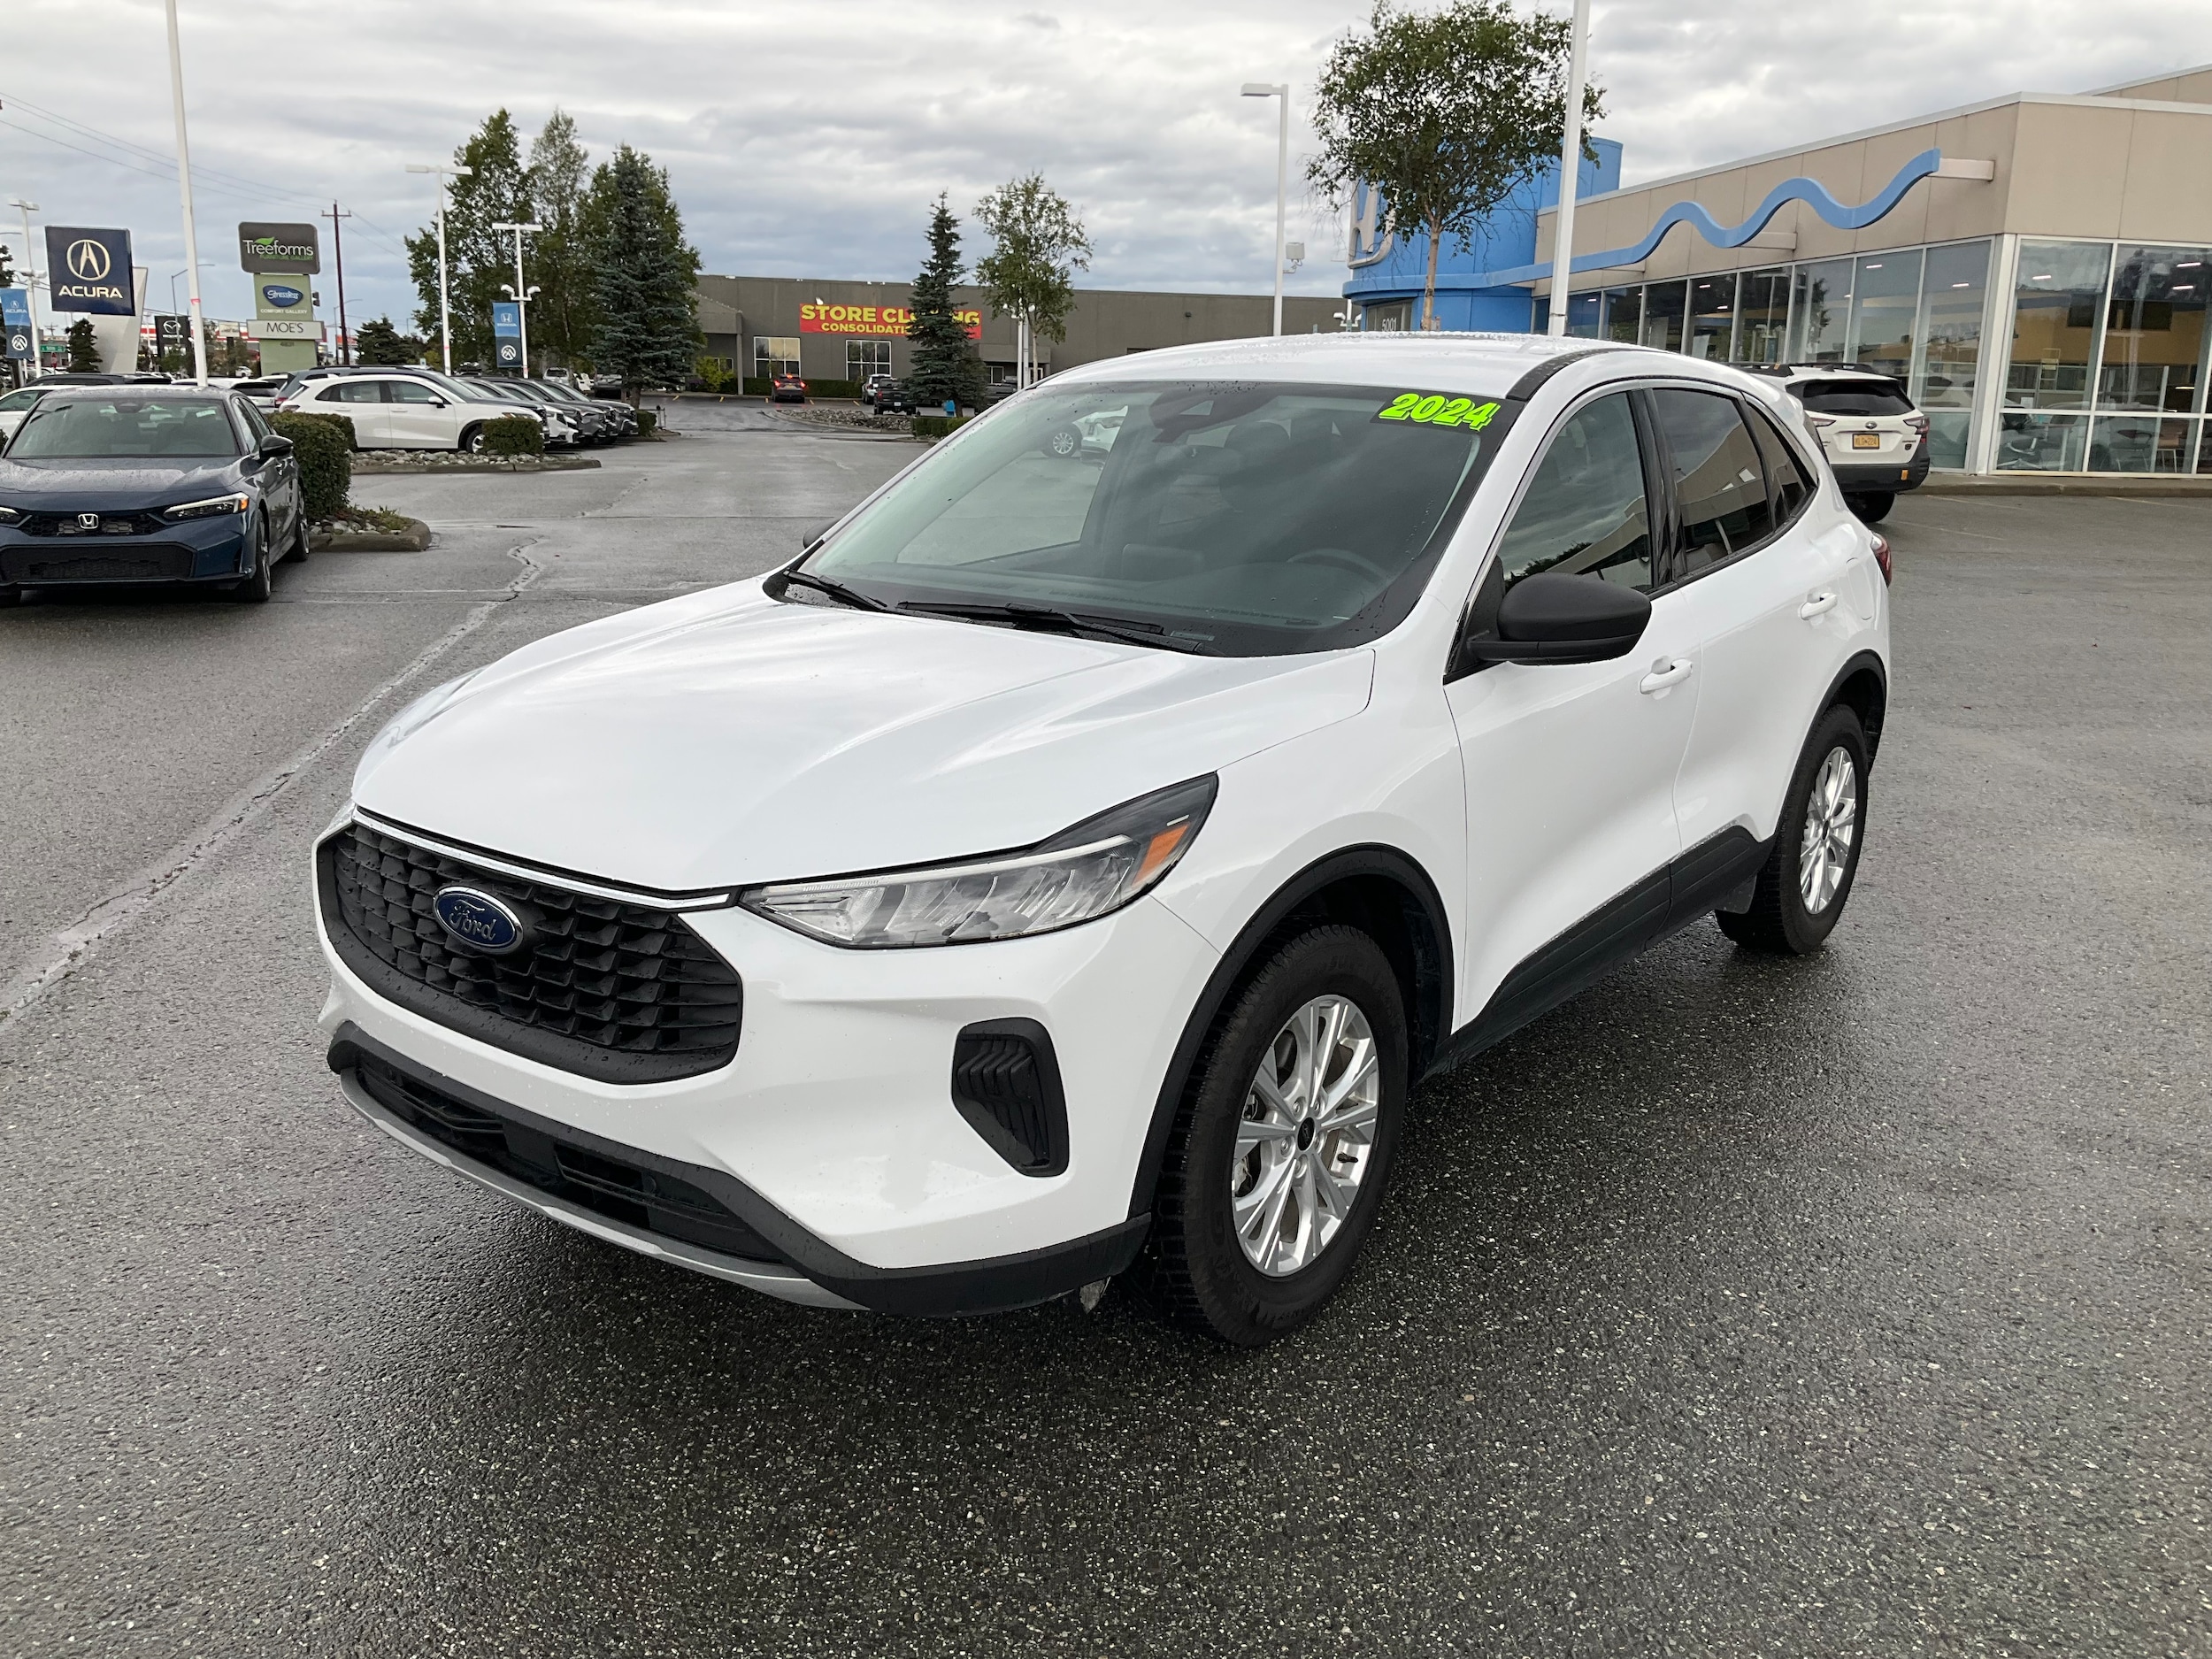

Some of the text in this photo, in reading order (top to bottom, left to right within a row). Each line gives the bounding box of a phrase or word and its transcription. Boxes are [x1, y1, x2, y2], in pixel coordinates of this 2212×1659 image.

[242, 239, 314, 256] Treeforms
[58, 285, 123, 298] ACURA
[267, 289, 299, 299] Stressless
[801, 304, 980, 327] STORE CLNG
[266, 322, 303, 334] MOE'S
[821, 322, 925, 335] CONSOLIDATI
[1381, 317, 1397, 332] 5001
[1379, 393, 1502, 432] 2024
[449, 899, 497, 941] Ford
